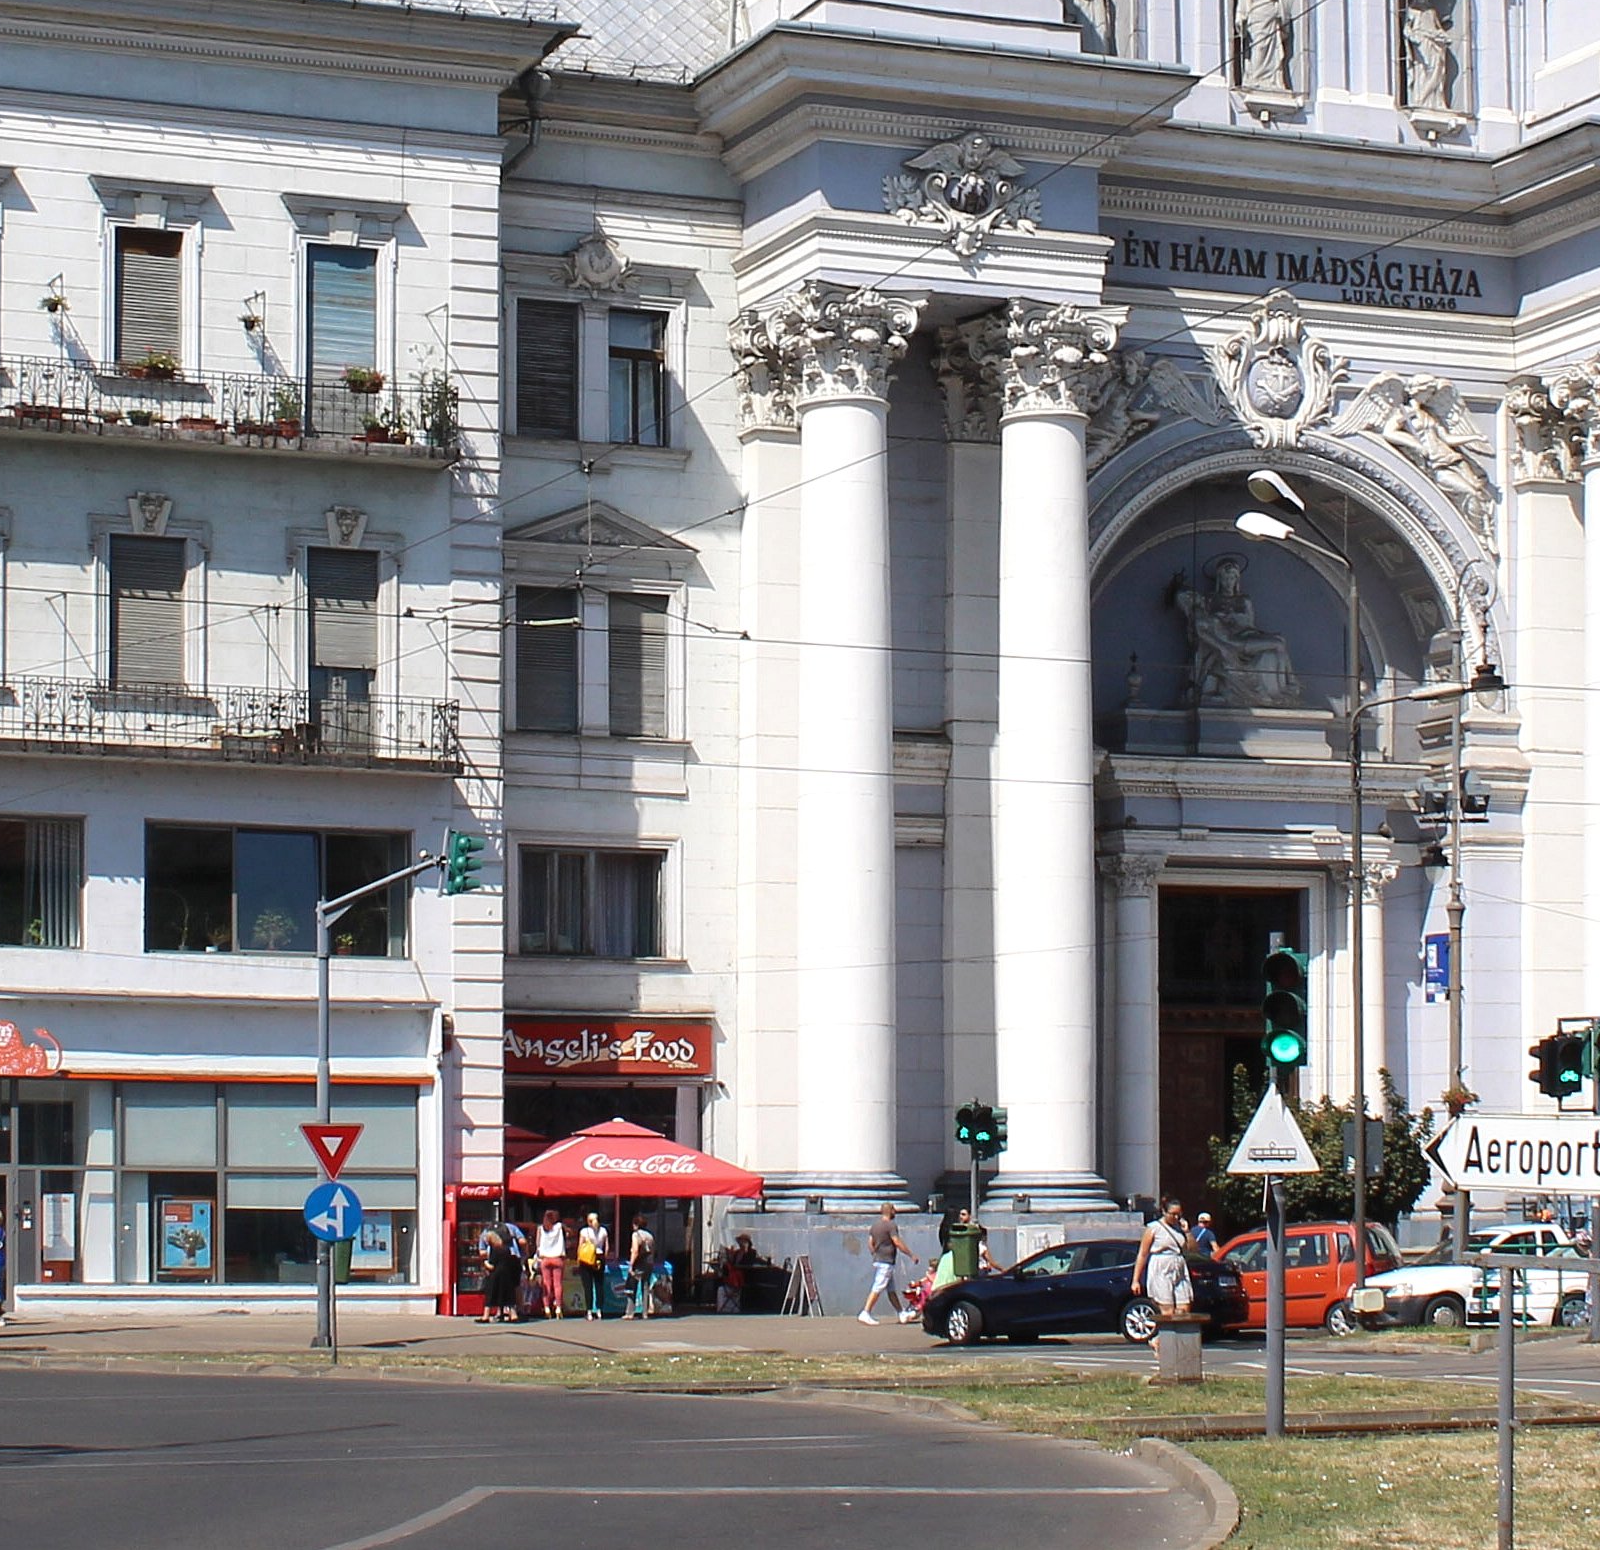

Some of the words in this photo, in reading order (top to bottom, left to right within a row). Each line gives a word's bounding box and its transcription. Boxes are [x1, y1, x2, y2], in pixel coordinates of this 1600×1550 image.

[1169, 236, 1267, 279] HÁZAM
[1276, 247, 1403, 292] IMÁDSÁG
[1409, 259, 1483, 298] HÁZA
[504, 1029, 624, 1067] Angeli's
[631, 1030, 696, 1062] Food
[583, 1153, 697, 1174] Coca-Cola
